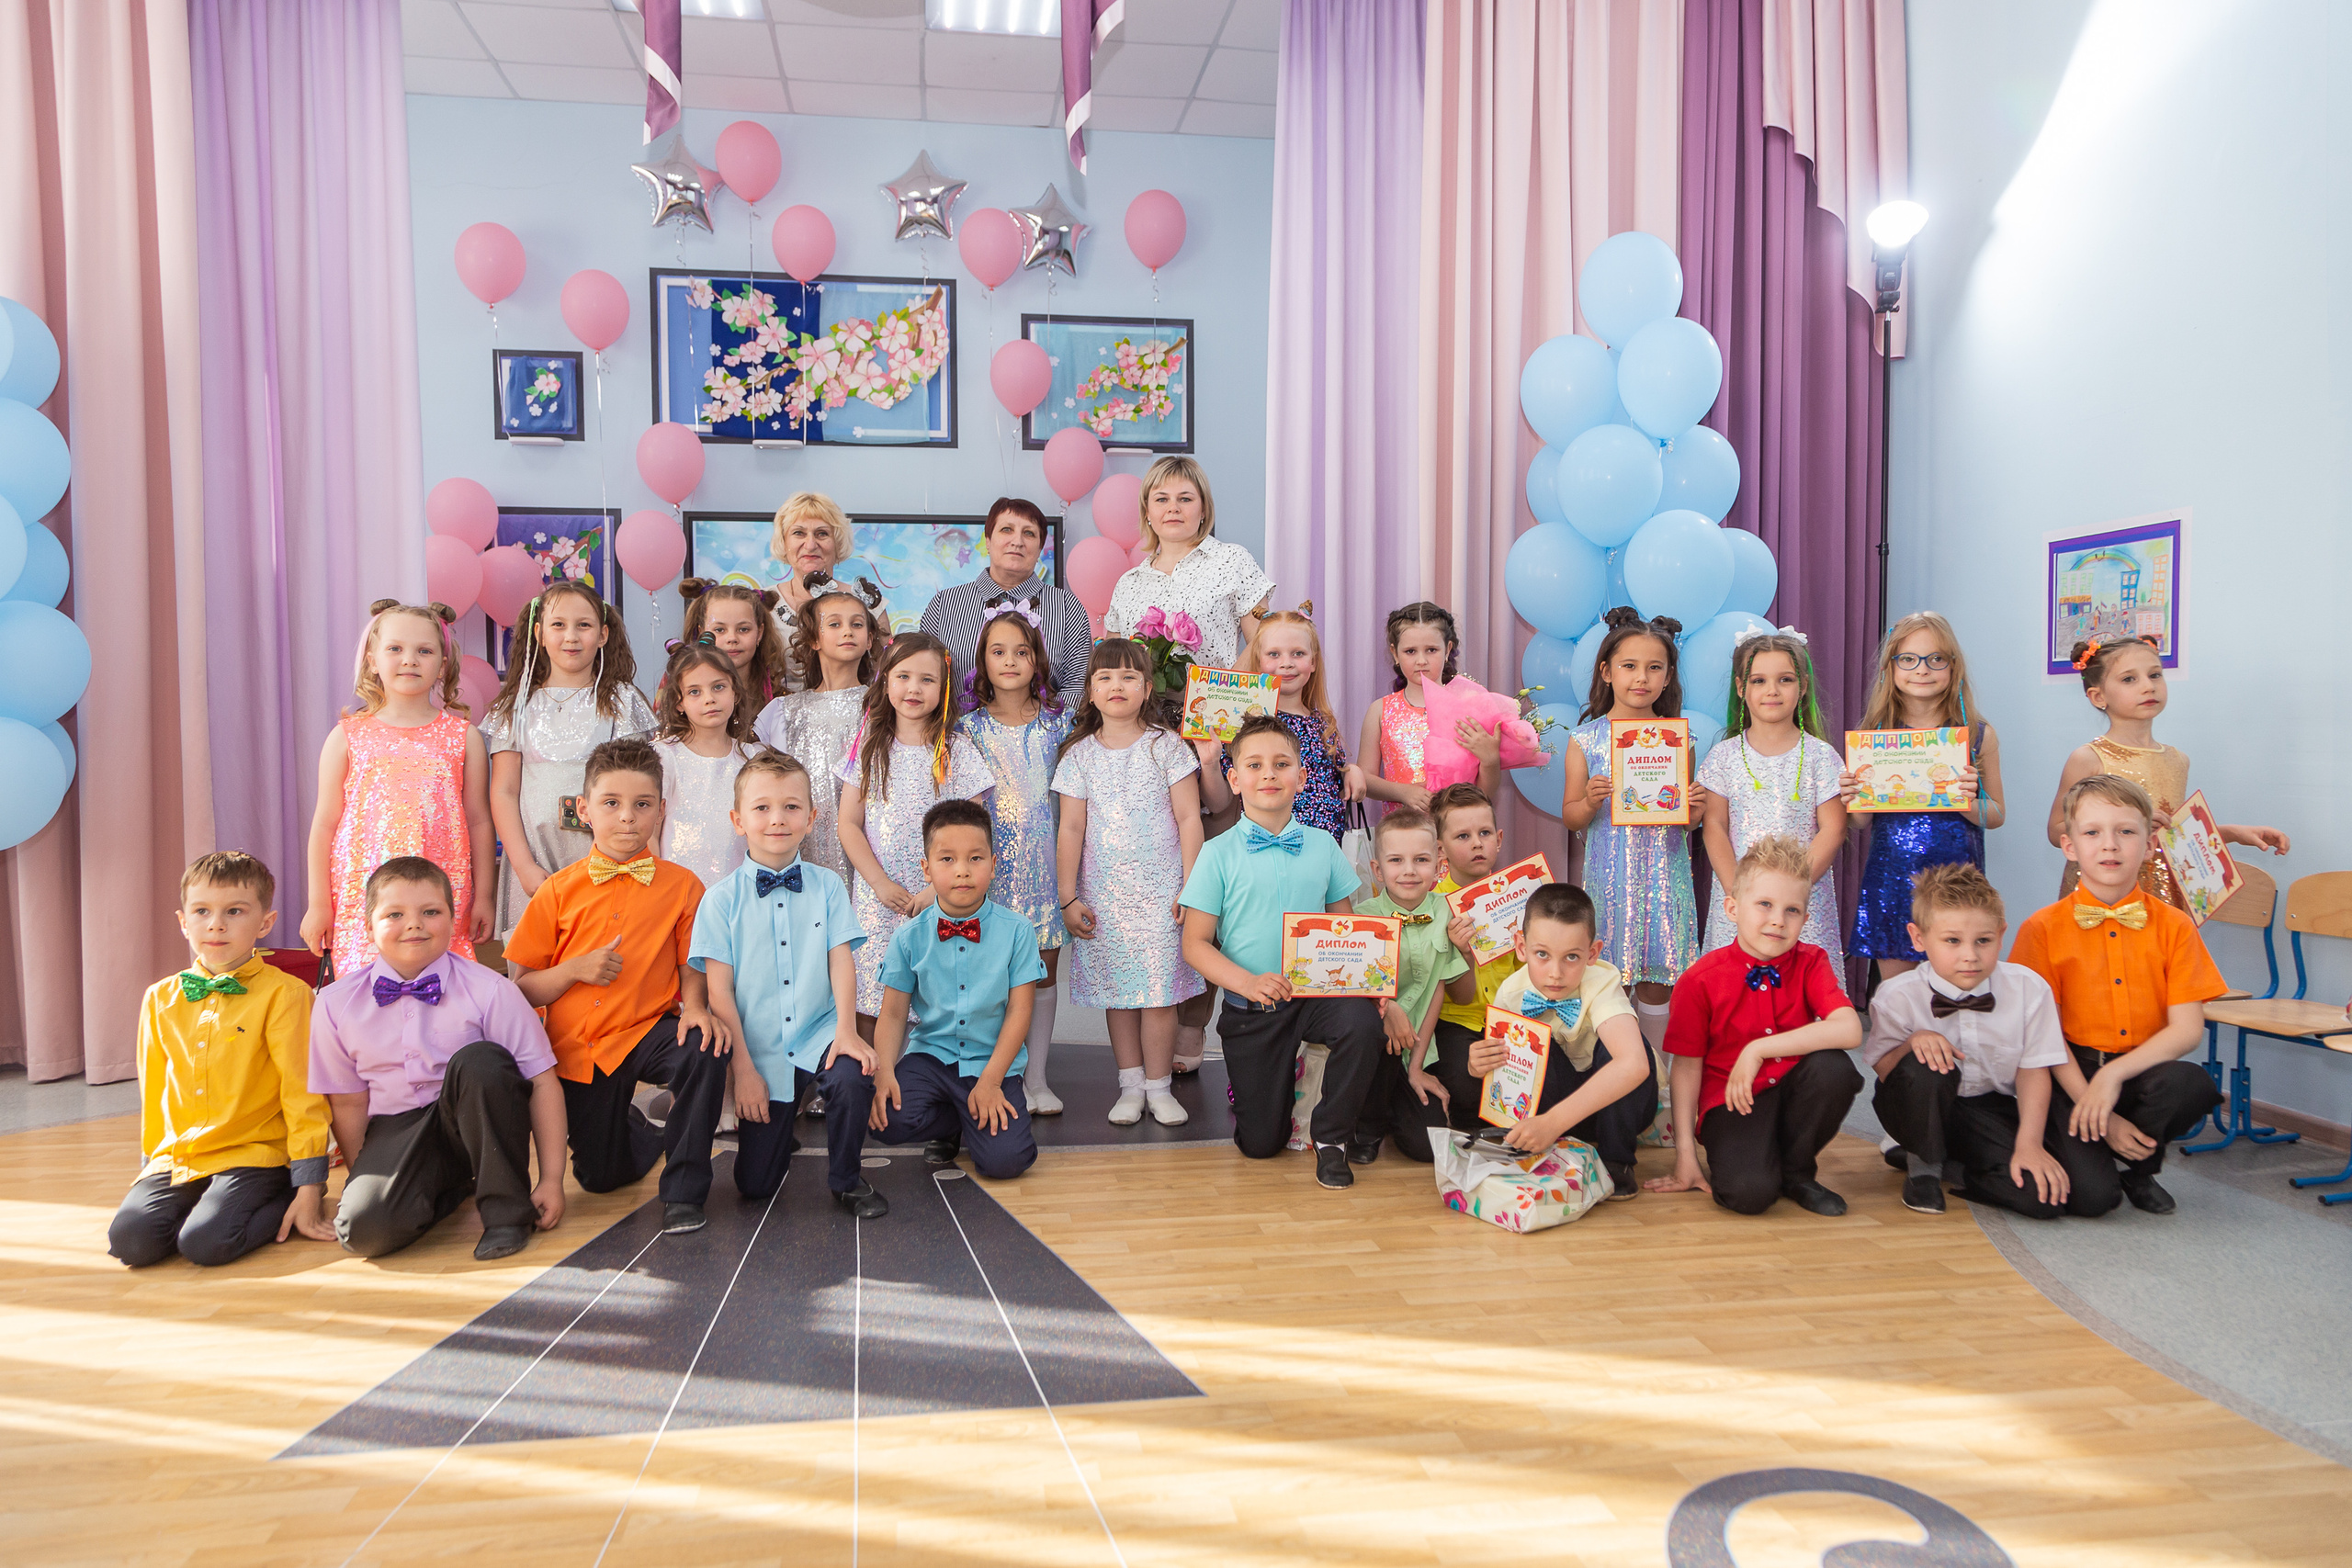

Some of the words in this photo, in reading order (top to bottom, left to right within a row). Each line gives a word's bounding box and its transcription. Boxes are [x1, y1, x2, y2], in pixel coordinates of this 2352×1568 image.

[1201, 670, 1259, 684] ДИПЛОМ
[1861, 731, 1937, 745] ДИПЛОМ
[1627, 755, 1672, 764] ДИПЛОМ
[2193, 832, 2216, 875] ДИПЛОМ
[1485, 887, 1528, 913] ДИПЛОМ
[1493, 909, 1516, 923] ДЕТСКОГО
[1517, 904, 1527, 912] САД
[1315, 939, 1367, 949] ДИПЛОМ
